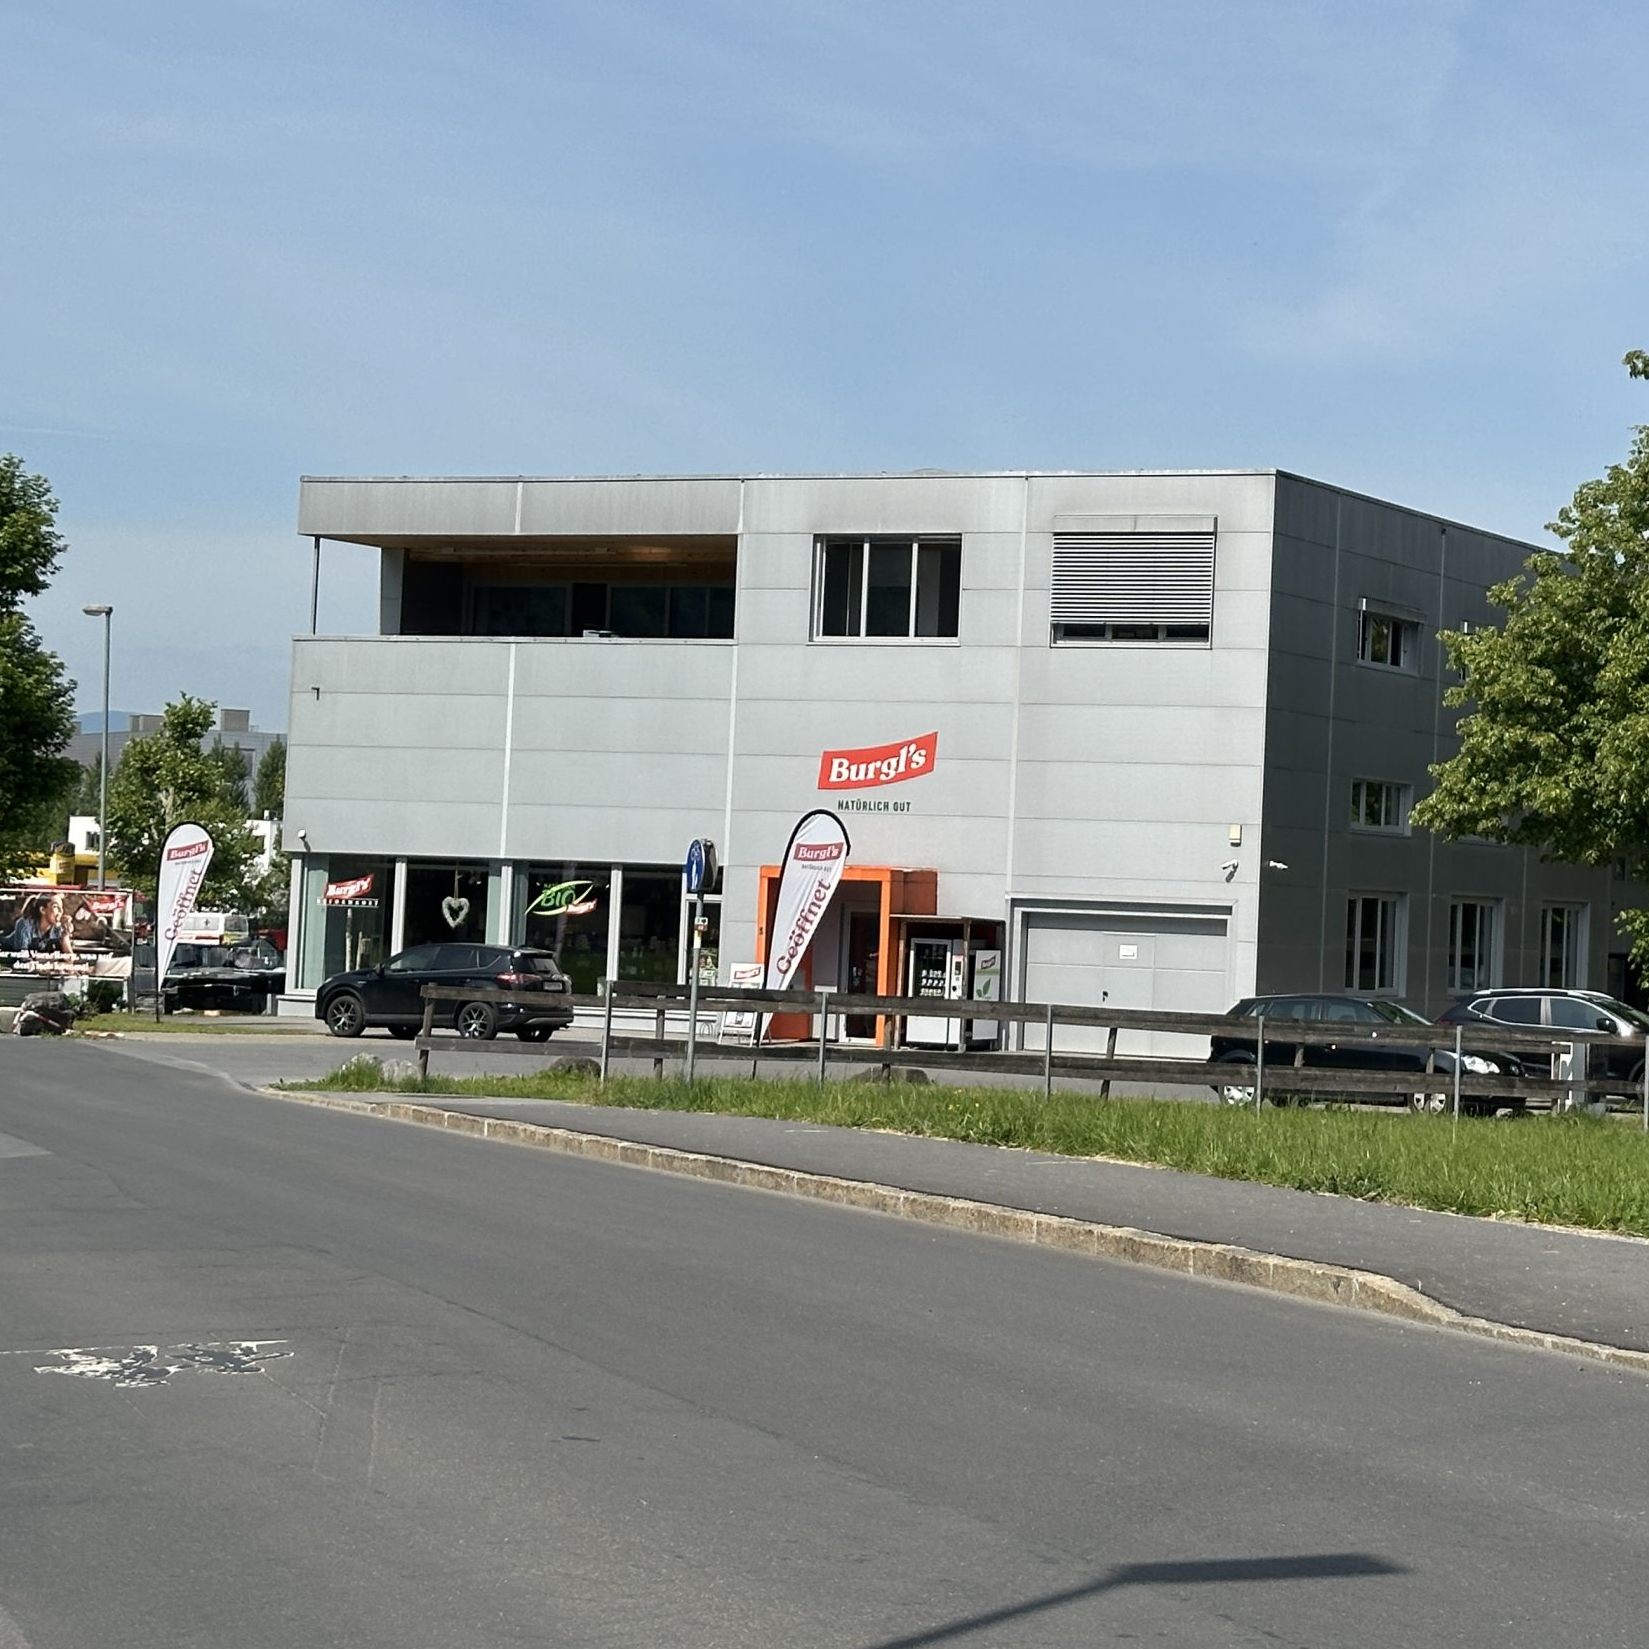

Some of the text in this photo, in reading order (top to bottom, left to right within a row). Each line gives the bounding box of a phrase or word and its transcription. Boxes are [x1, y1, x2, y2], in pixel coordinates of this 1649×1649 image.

[829, 743, 927, 782] Burgl's
[837, 799, 912, 812] NATÜRLICH GUT
[798, 845, 839, 861] Burgl's
[165, 869, 202, 940] Geöffnet
[541, 888, 576, 907] BIO
[776, 878, 831, 975] Geöffnet
